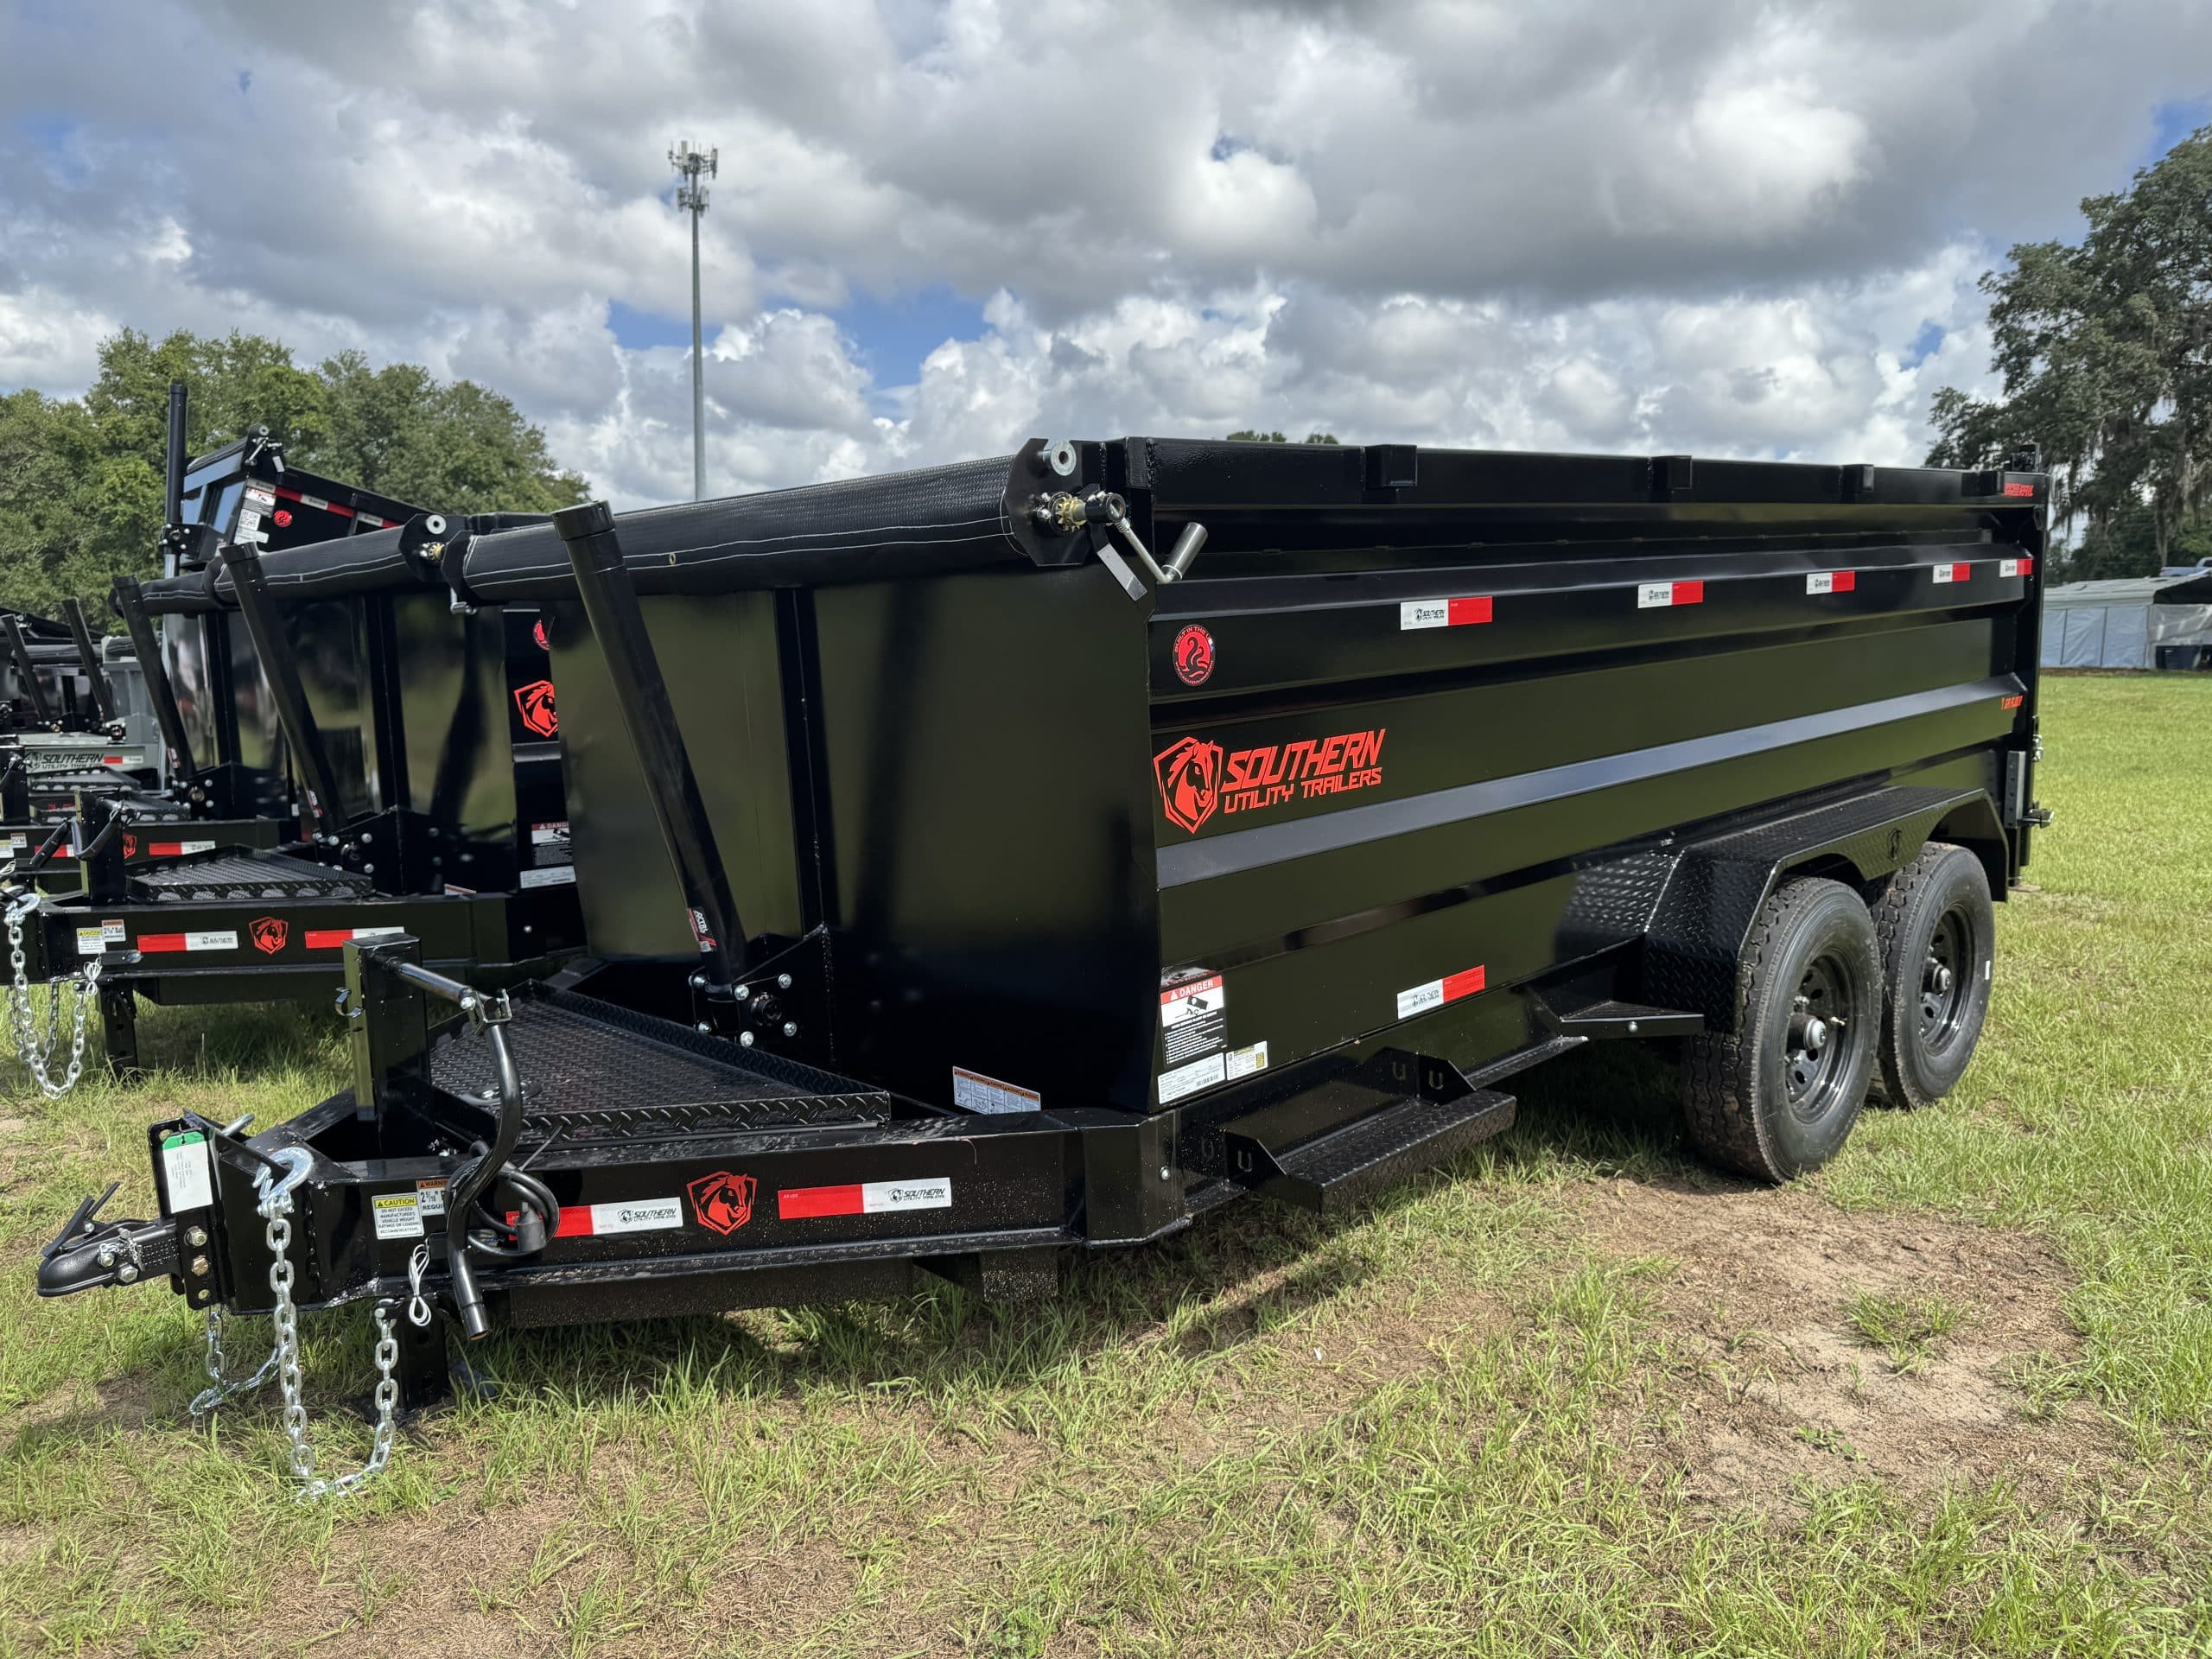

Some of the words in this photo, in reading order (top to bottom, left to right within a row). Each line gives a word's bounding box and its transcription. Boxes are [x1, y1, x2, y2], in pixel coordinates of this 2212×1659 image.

[41, 753, 104, 764] SOUTHERN
[1220, 728, 1386, 793] SOUTHERN
[1224, 784, 1294, 814] UTILITY
[1300, 767, 1382, 798] TRAILERS
[1179, 979, 1214, 997] DANGER
[903, 1188, 946, 1197] SOUTHERN
[384, 1198, 415, 1206] CAUTION
[634, 1208, 677, 1218] SOUTHERN
